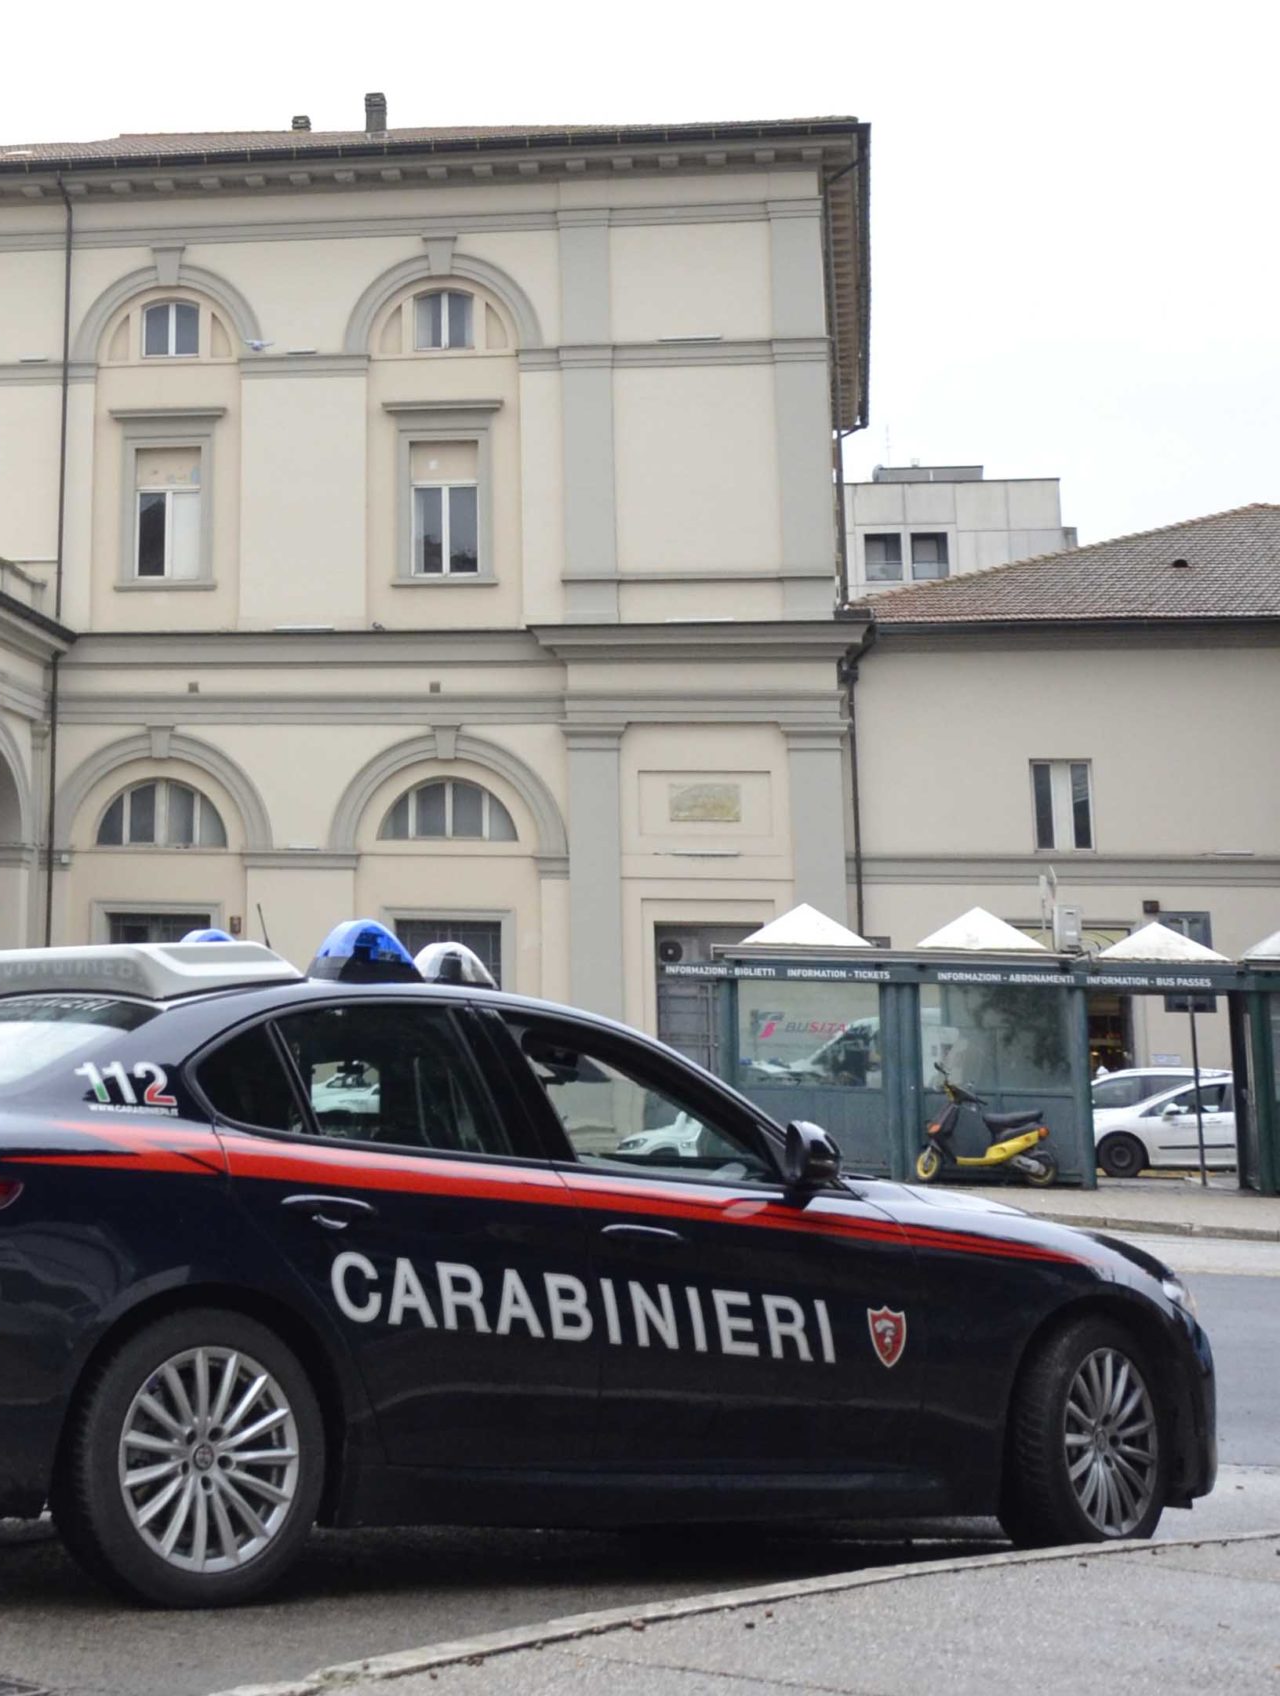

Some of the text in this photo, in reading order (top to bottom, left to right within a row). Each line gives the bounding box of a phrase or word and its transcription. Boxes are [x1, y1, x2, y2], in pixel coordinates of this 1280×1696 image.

[665, 965, 727, 975] INFORMAZIONI
[734, 967, 776, 976] BIGLIETTI
[787, 968, 847, 978] INFORMATION
[854, 970, 890, 979] TICKETS
[937, 972, 1002, 982] INFORMAZIONI
[1009, 974, 1075, 984] ABBONAMENTI
[1086, 976, 1148, 986] INFORMATION
[1156, 977, 1175, 986] BUS
[1176, 978, 1211, 987] PASSES
[74, 1061, 177, 1106] 112
[330, 1251, 836, 1364] CARABINIERI
